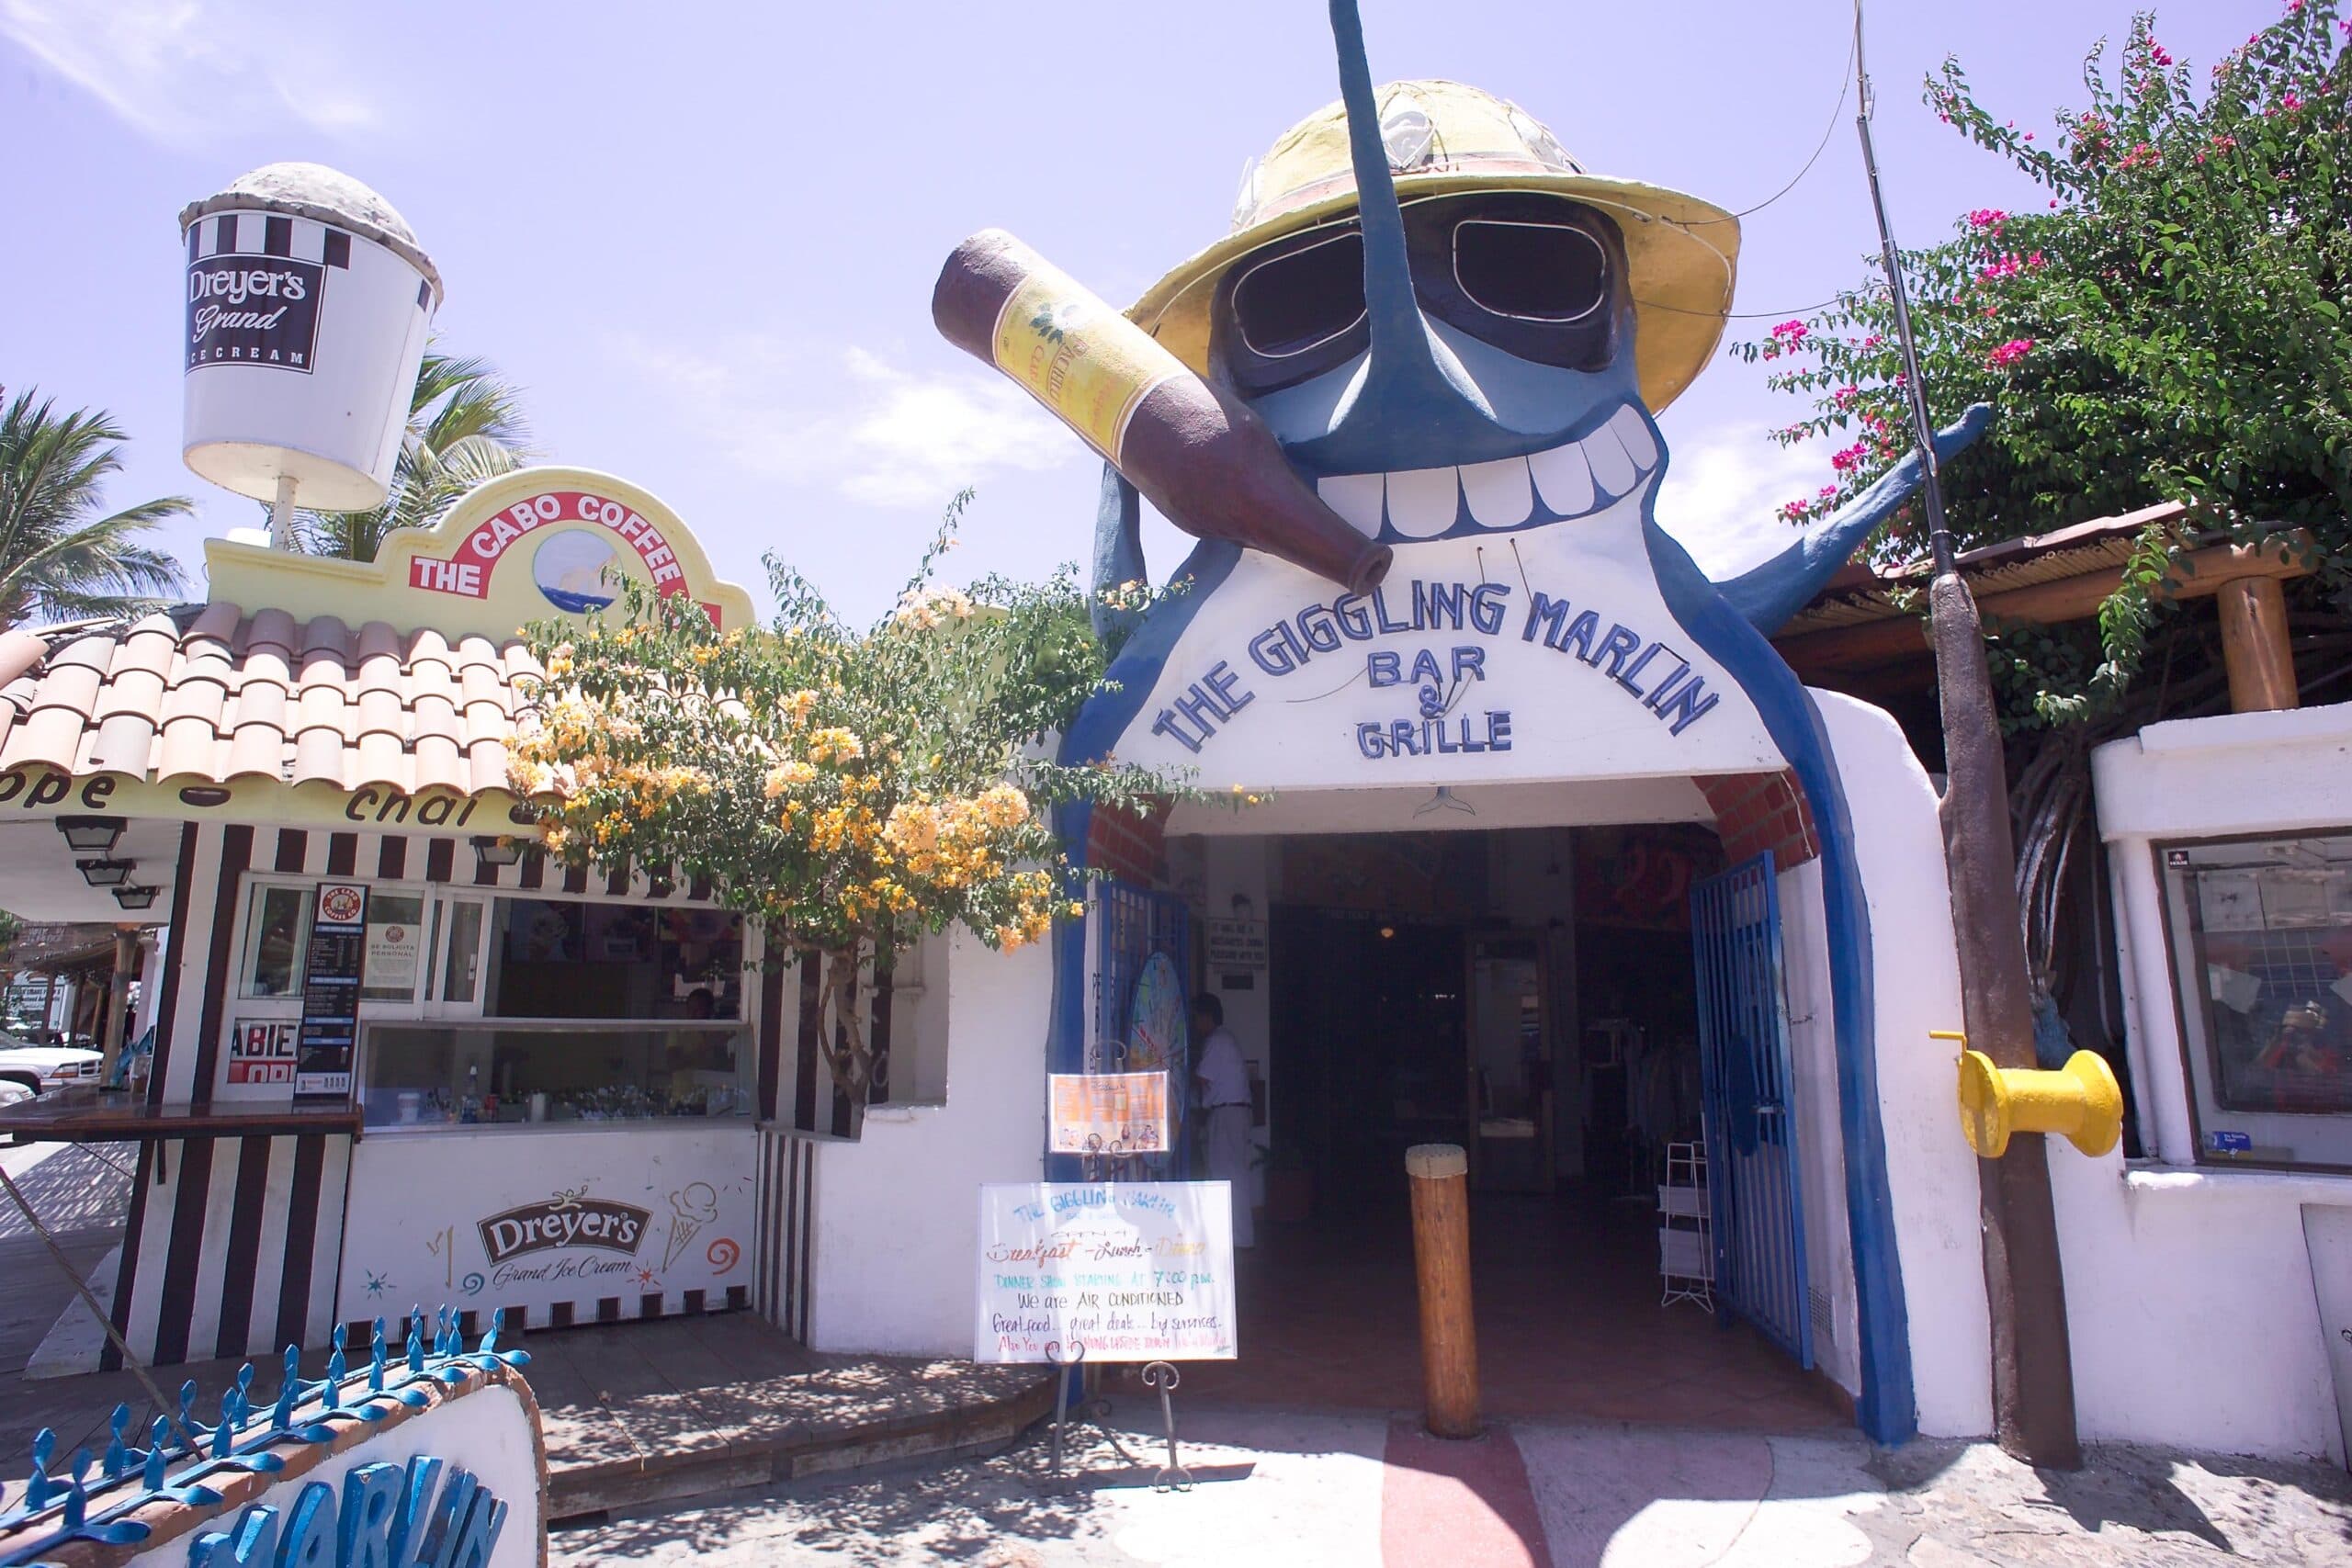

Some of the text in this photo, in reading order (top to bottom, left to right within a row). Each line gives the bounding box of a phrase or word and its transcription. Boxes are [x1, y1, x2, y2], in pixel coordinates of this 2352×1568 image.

[189, 270, 306, 304] Dreyer's
[192, 305, 288, 344] Grand
[215, 346, 304, 364] CREAM
[413, 495, 682, 596] THE CABO COFFEE
[1151, 580, 1720, 754] THE GIGGLING MARLIN
[1367, 646, 1486, 688] BAR
[1418, 684, 1446, 719] &
[1356, 710, 1512, 759] GRILLE
[326, 888, 358, 901] THE CABO
[324, 906, 345, 919] COFFEE
[232, 1023, 300, 1056] ABIE
[490, 1211, 639, 1258] Dreyer's
[987, 1237, 1082, 1269] Breakfast
[492, 1255, 634, 1292] Grand Ice Cream
[1153, 1269, 1187, 1287] 7:00
[1017, 1292, 1184, 1311] We are AIR CONDITIONED
[992, 1313, 1023, 1333] Great
[1069, 1313, 1100, 1340] great
